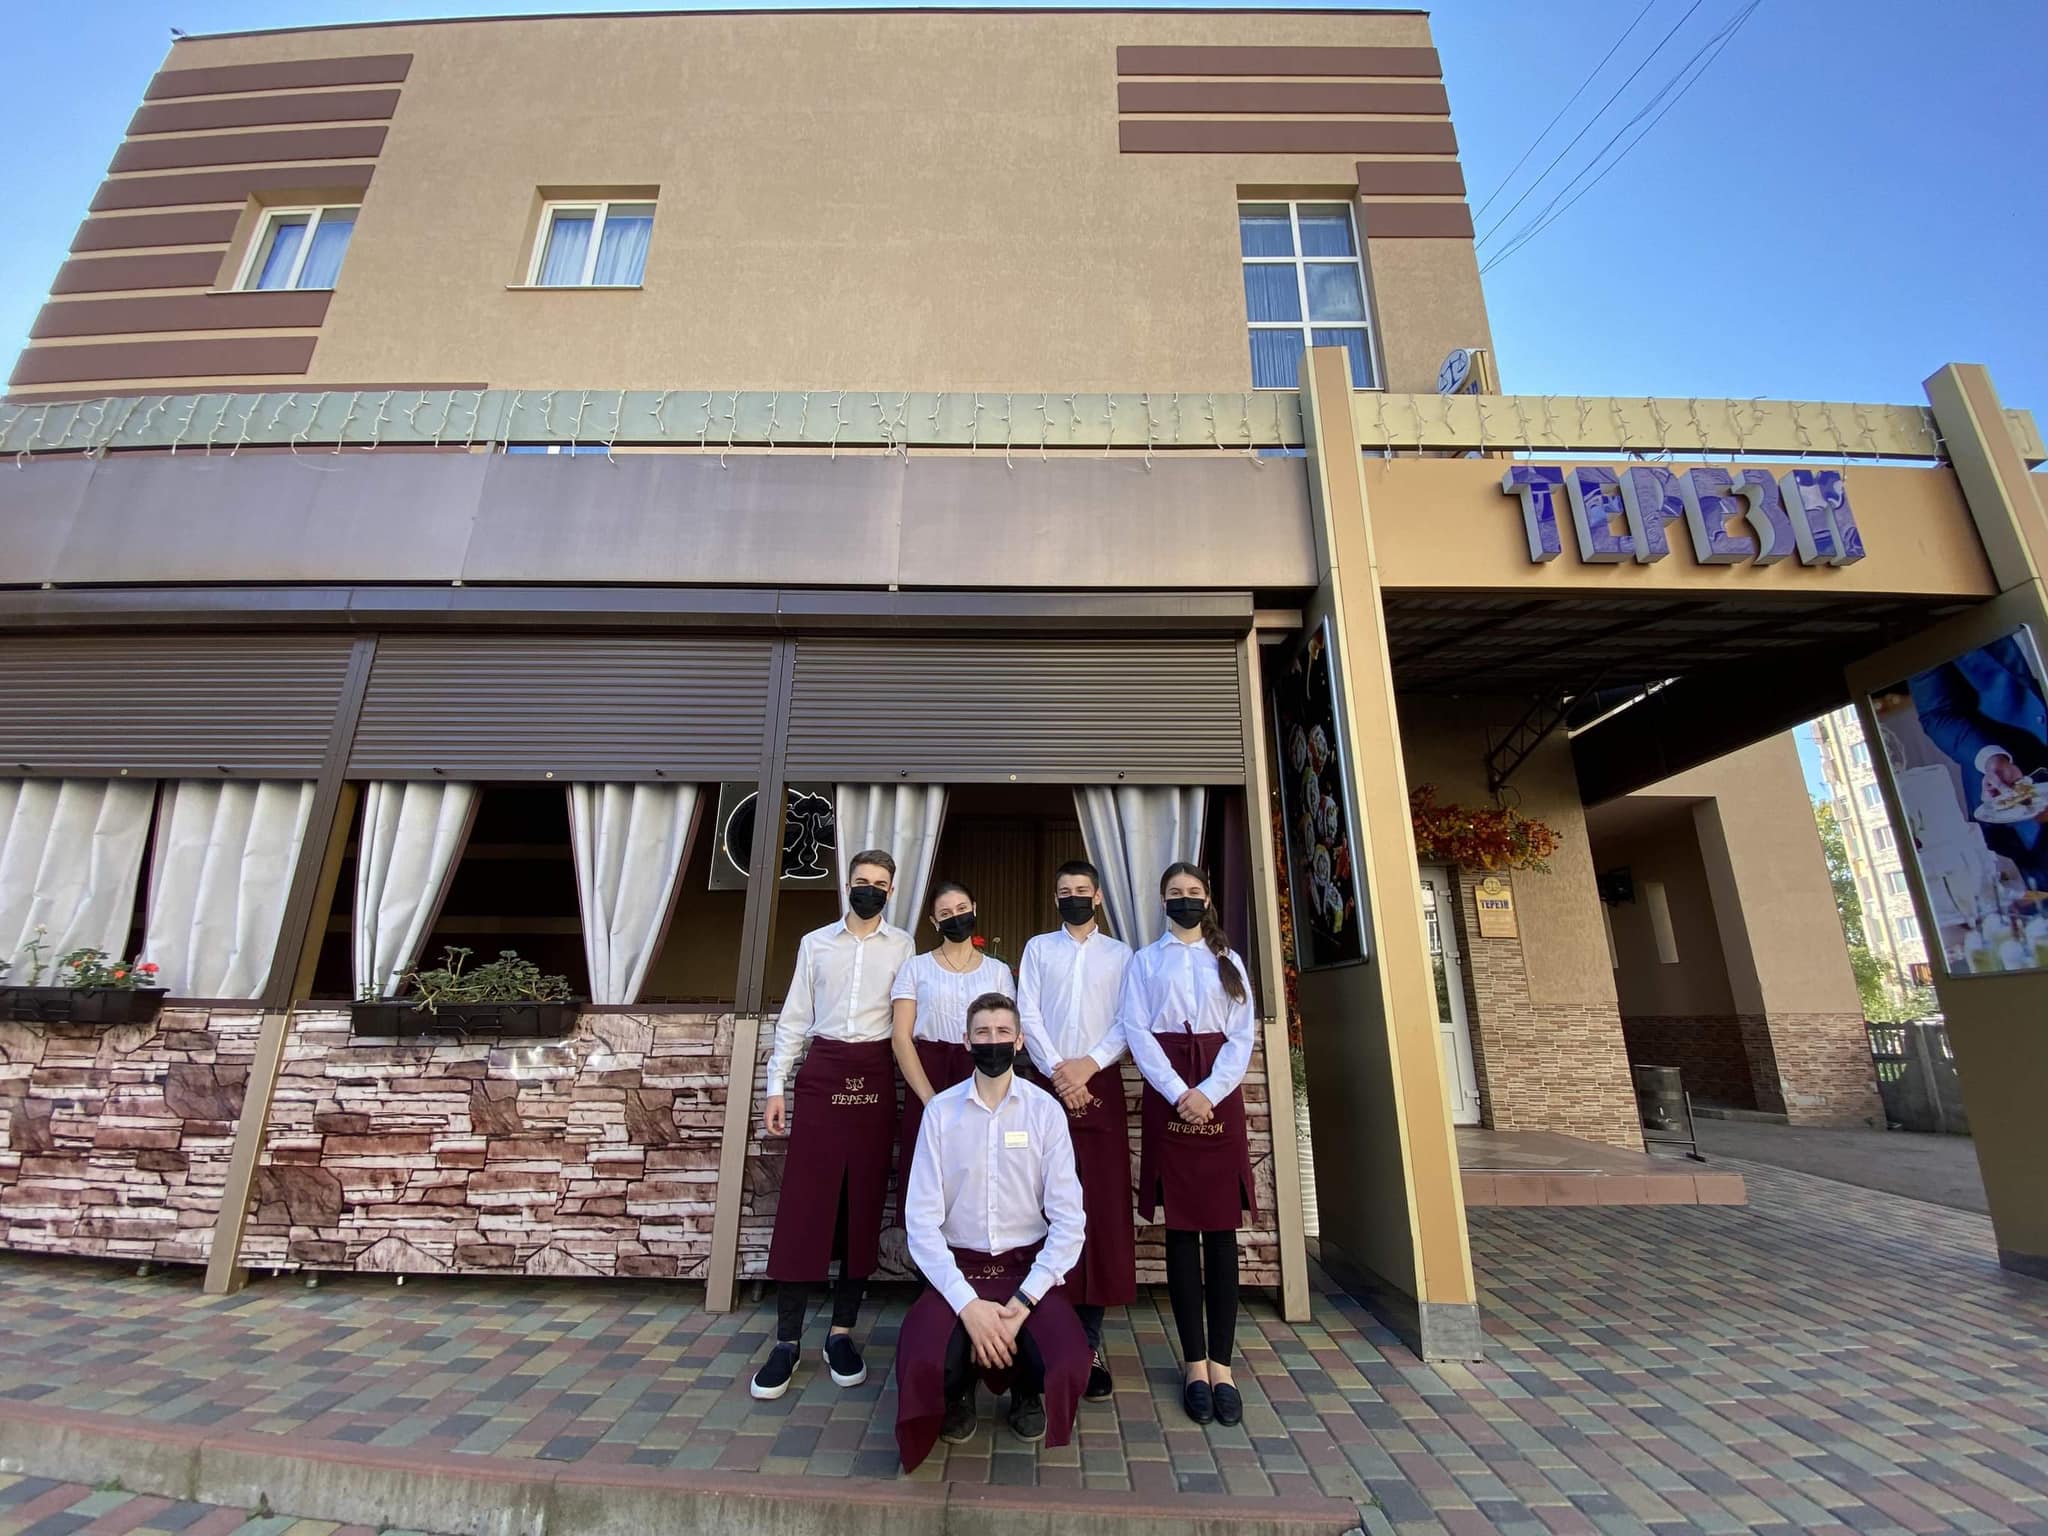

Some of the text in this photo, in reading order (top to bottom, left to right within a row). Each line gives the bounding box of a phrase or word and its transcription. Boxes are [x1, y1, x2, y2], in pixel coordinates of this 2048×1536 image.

[1501, 465, 1866, 567] ТЕРЕЗИ
[831, 1093, 879, 1105] ТЕРЕЗИ
[1168, 1121, 1225, 1135] ТЕРЕЗИ
